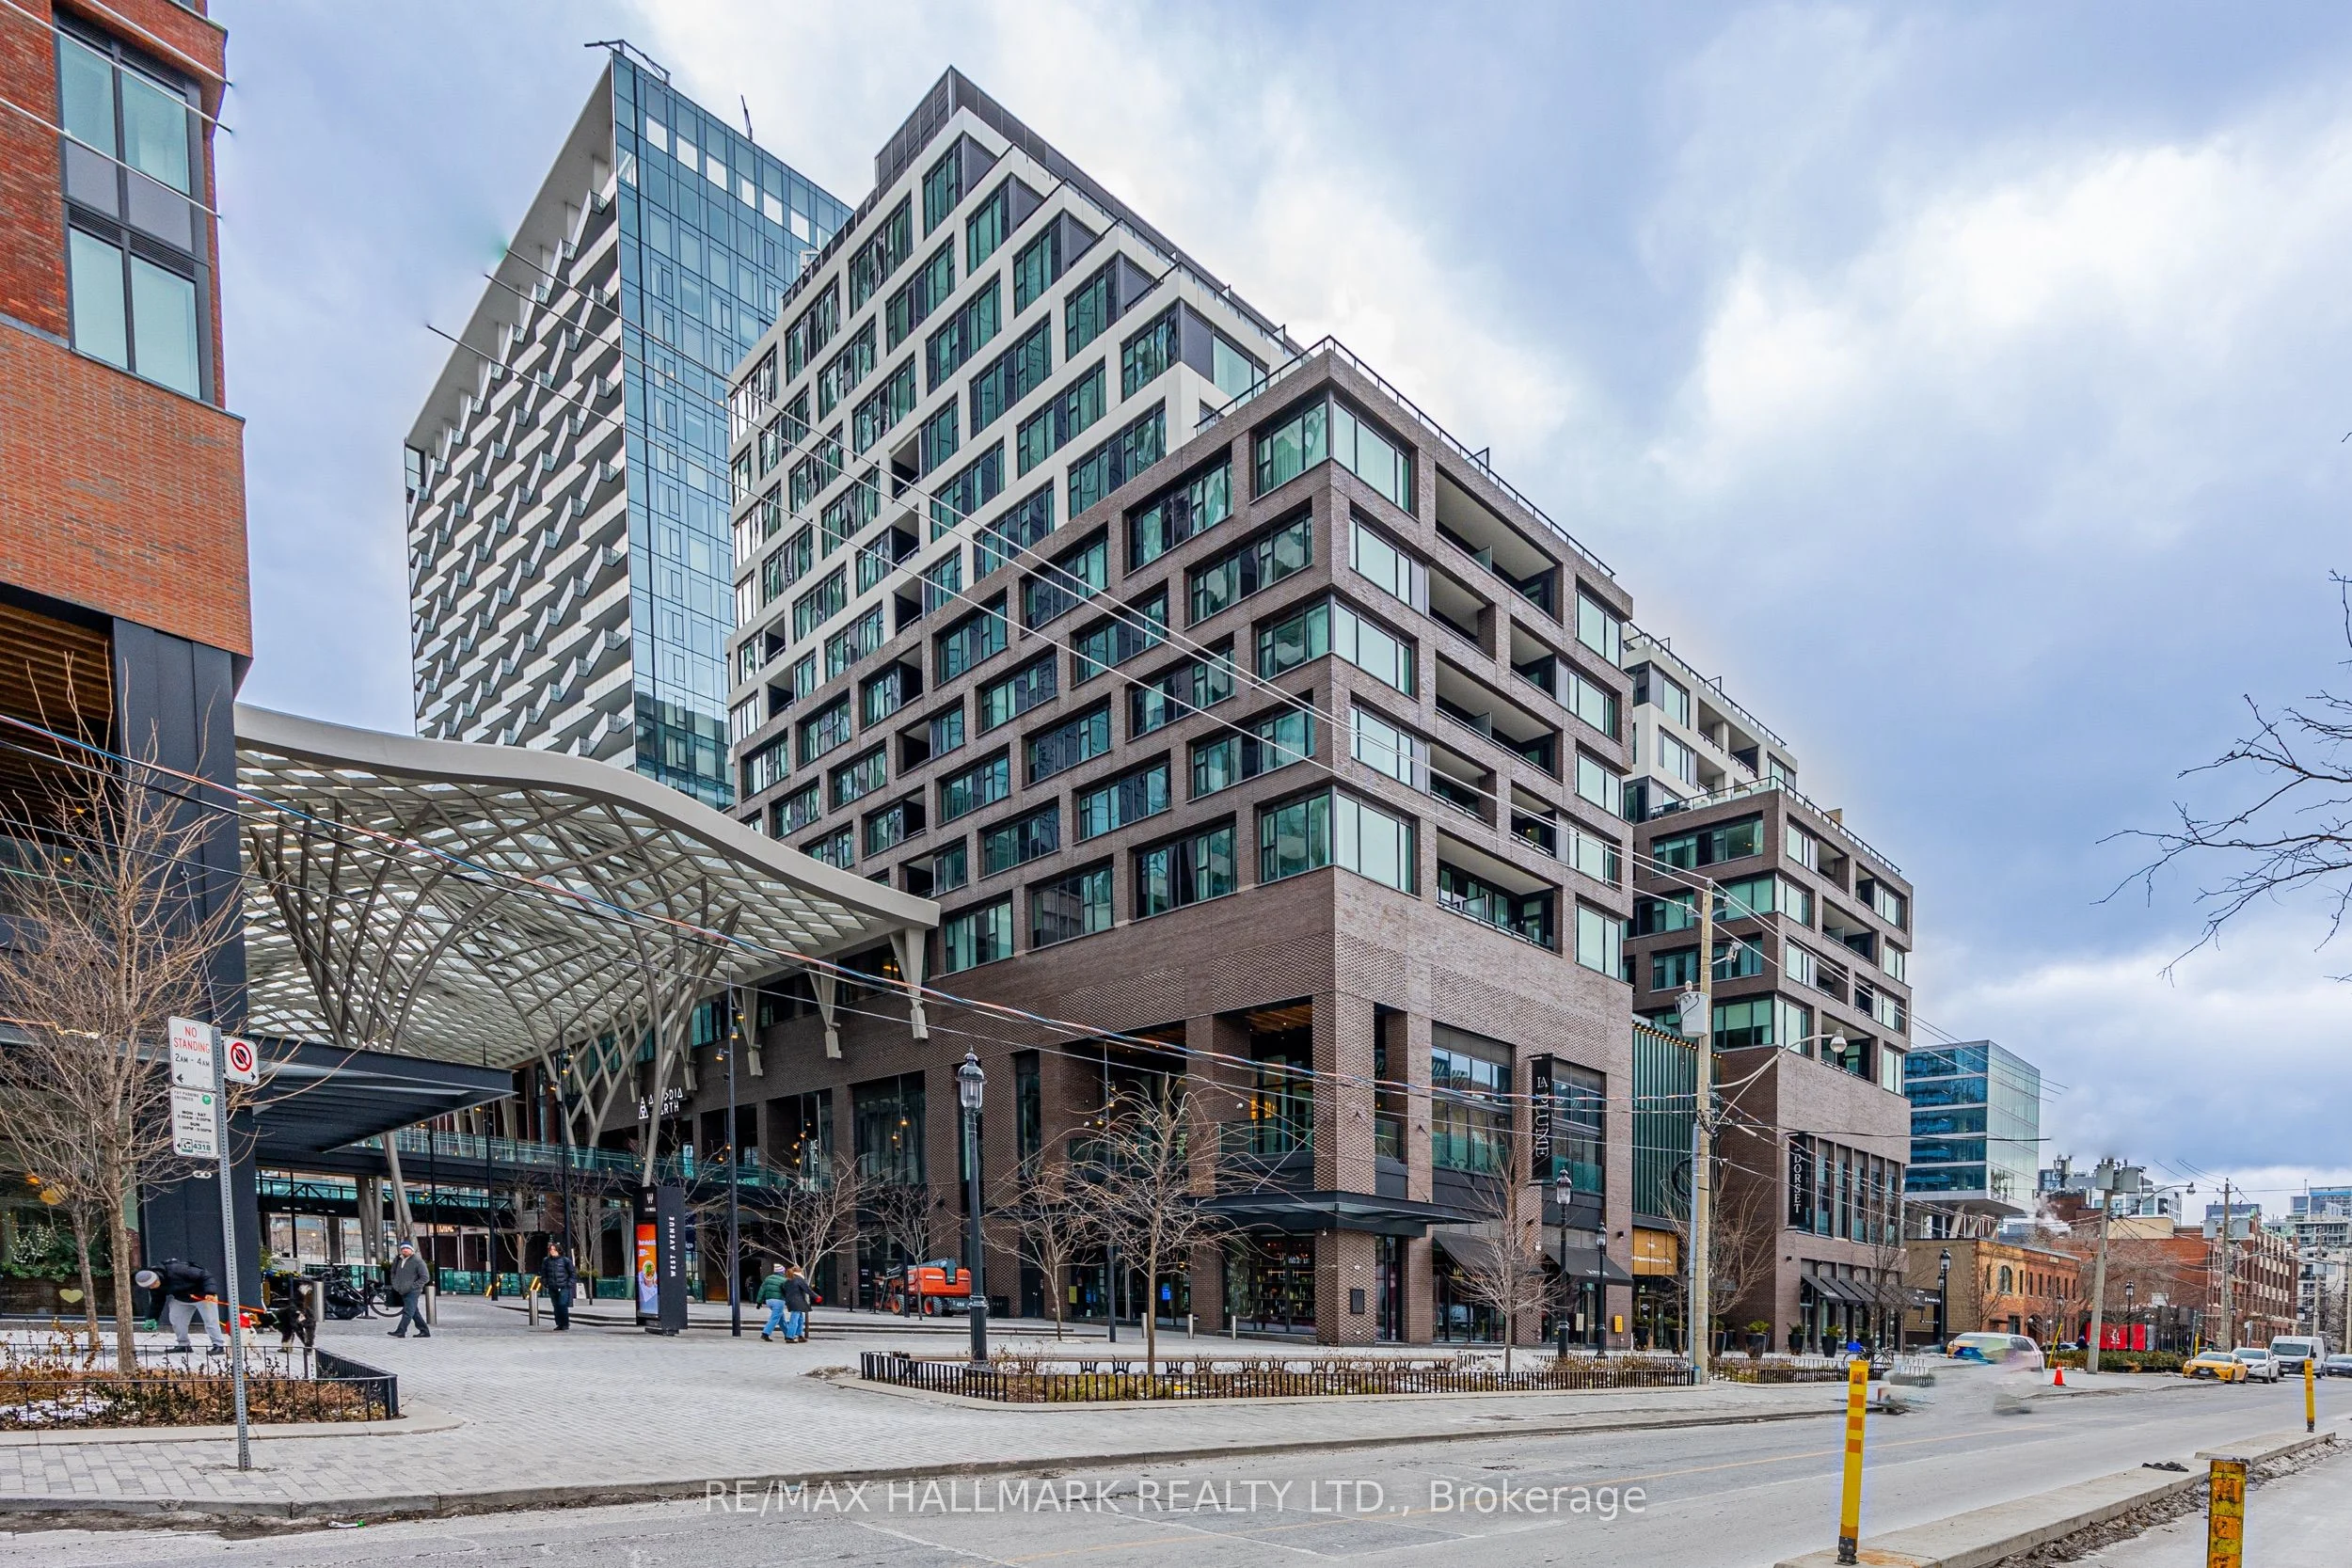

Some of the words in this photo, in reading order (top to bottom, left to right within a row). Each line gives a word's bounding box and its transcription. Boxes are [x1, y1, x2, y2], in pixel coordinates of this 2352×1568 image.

[184, 1026, 198, 1037] NO
[173, 1037, 211, 1053] STANDING
[175, 1053, 188, 1063] 2AM
[197, 1057, 211, 1067] 4AM
[1536, 1076, 1549, 1088] LA
[1535, 1093, 1549, 1158] PLUME
[193, 1143, 212, 1151] 4318
[1793, 1153, 1803, 1213] DORSET
